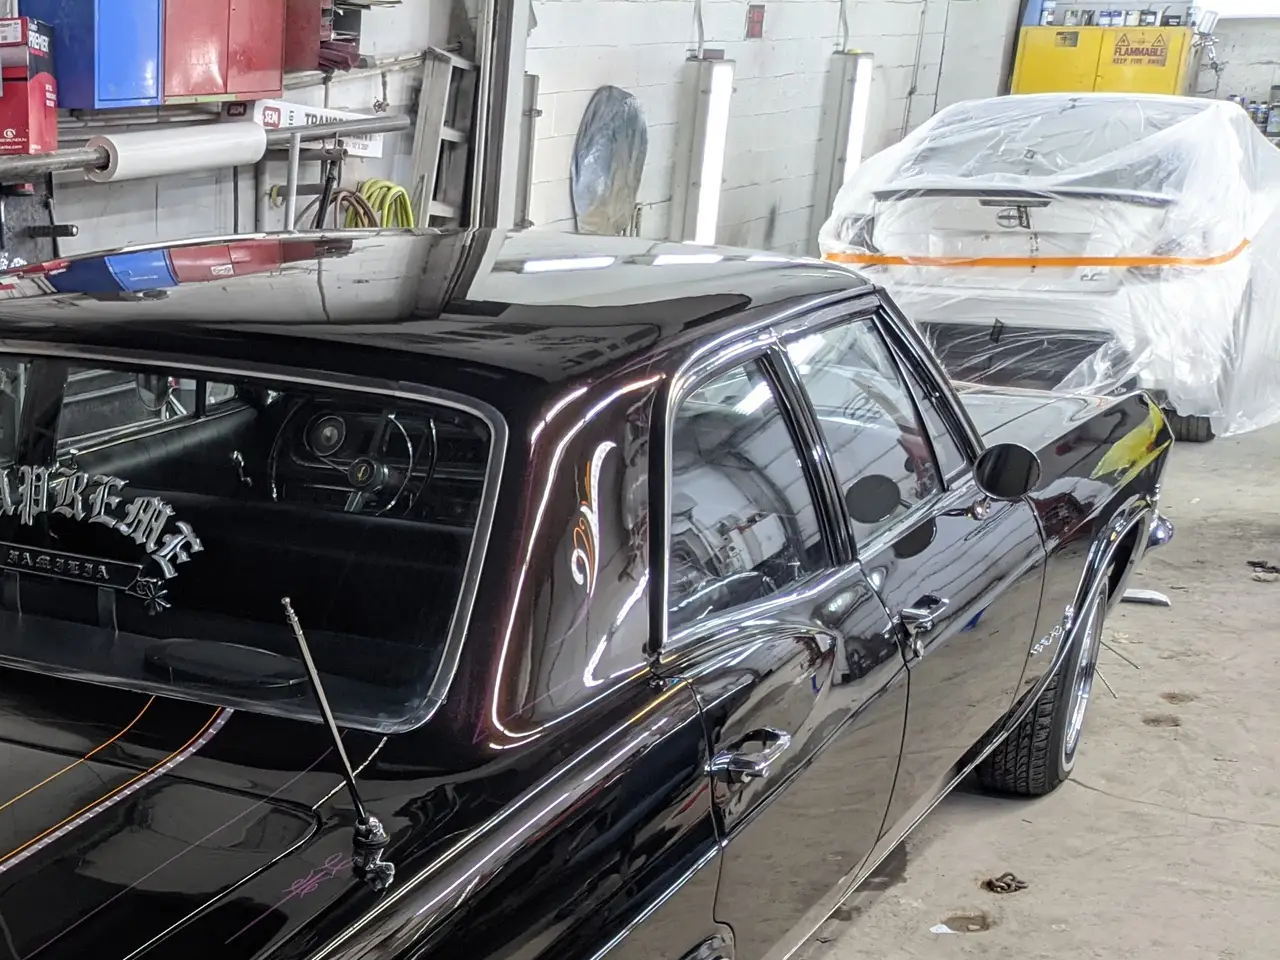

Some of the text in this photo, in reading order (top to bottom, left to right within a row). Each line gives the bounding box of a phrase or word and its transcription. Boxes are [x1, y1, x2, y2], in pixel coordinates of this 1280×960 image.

[1114, 47, 1166, 57] FLAMMABLE
[264, 109, 279, 125] SEM
[6, 549, 111, 580] FAMILIA
